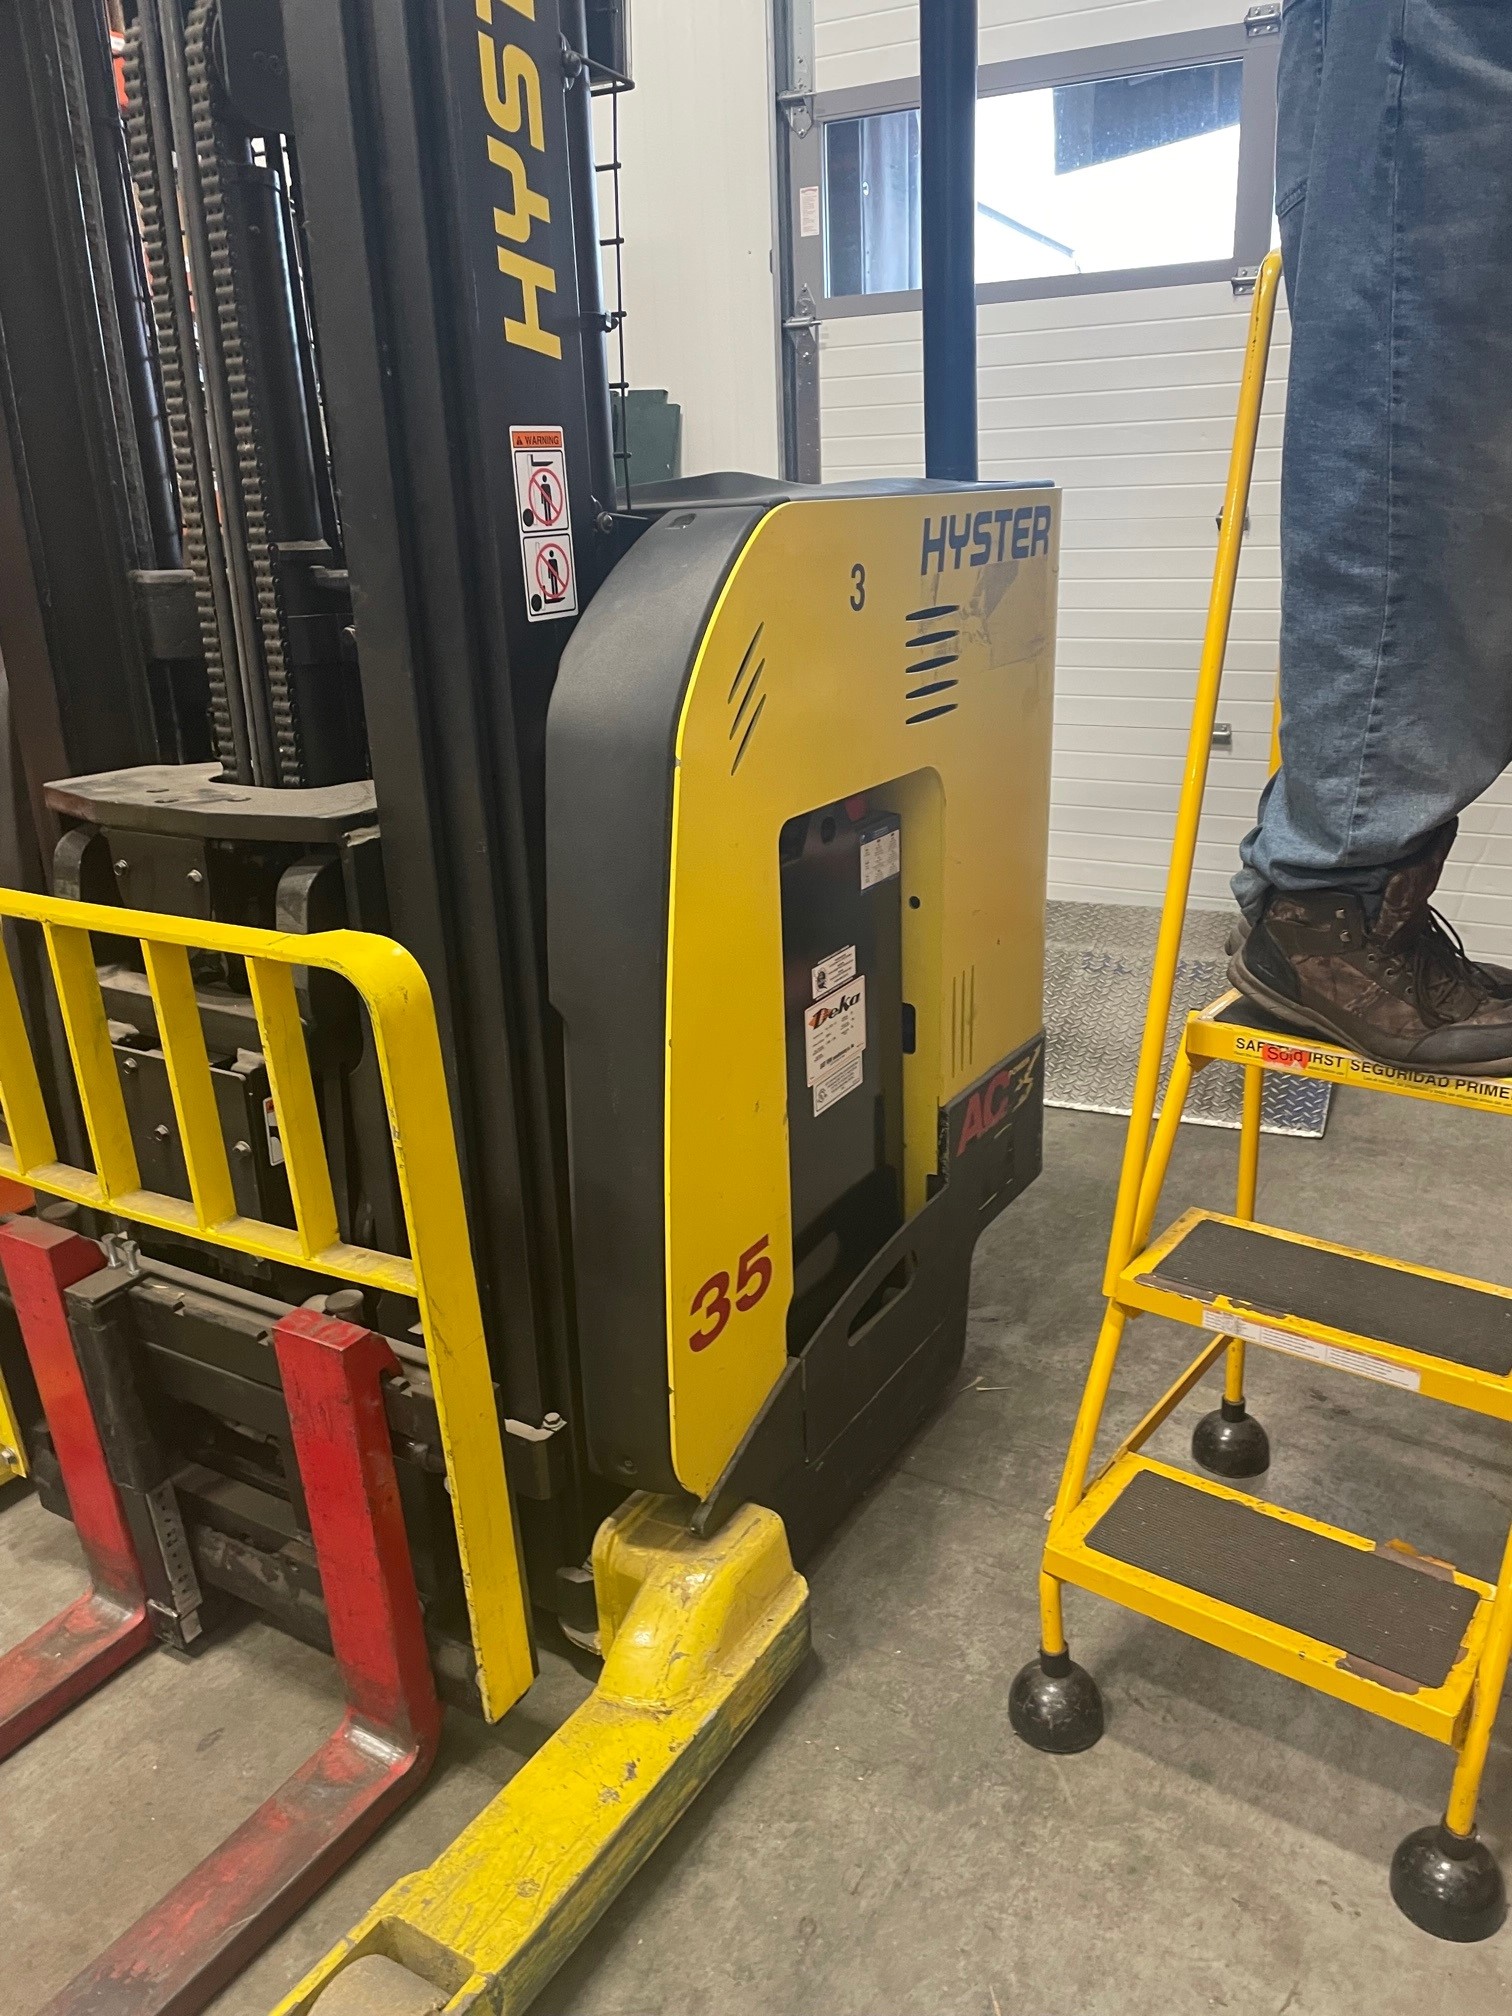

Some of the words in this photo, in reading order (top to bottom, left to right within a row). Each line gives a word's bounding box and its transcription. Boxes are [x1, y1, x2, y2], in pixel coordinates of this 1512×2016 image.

[475, 0, 562, 360] HYS
[525, 436, 559, 445] WARNING
[921, 505, 1051, 576] HYSTER
[850, 563, 866, 611] 3
[809, 992, 861, 1030] Deka
[1304, 1051, 1345, 1068] IRST
[1350, 1058, 1450, 1088] SEGURIDAD
[1455, 1078, 1512, 1100] PRIME
[689, 1233, 772, 1352] 35
